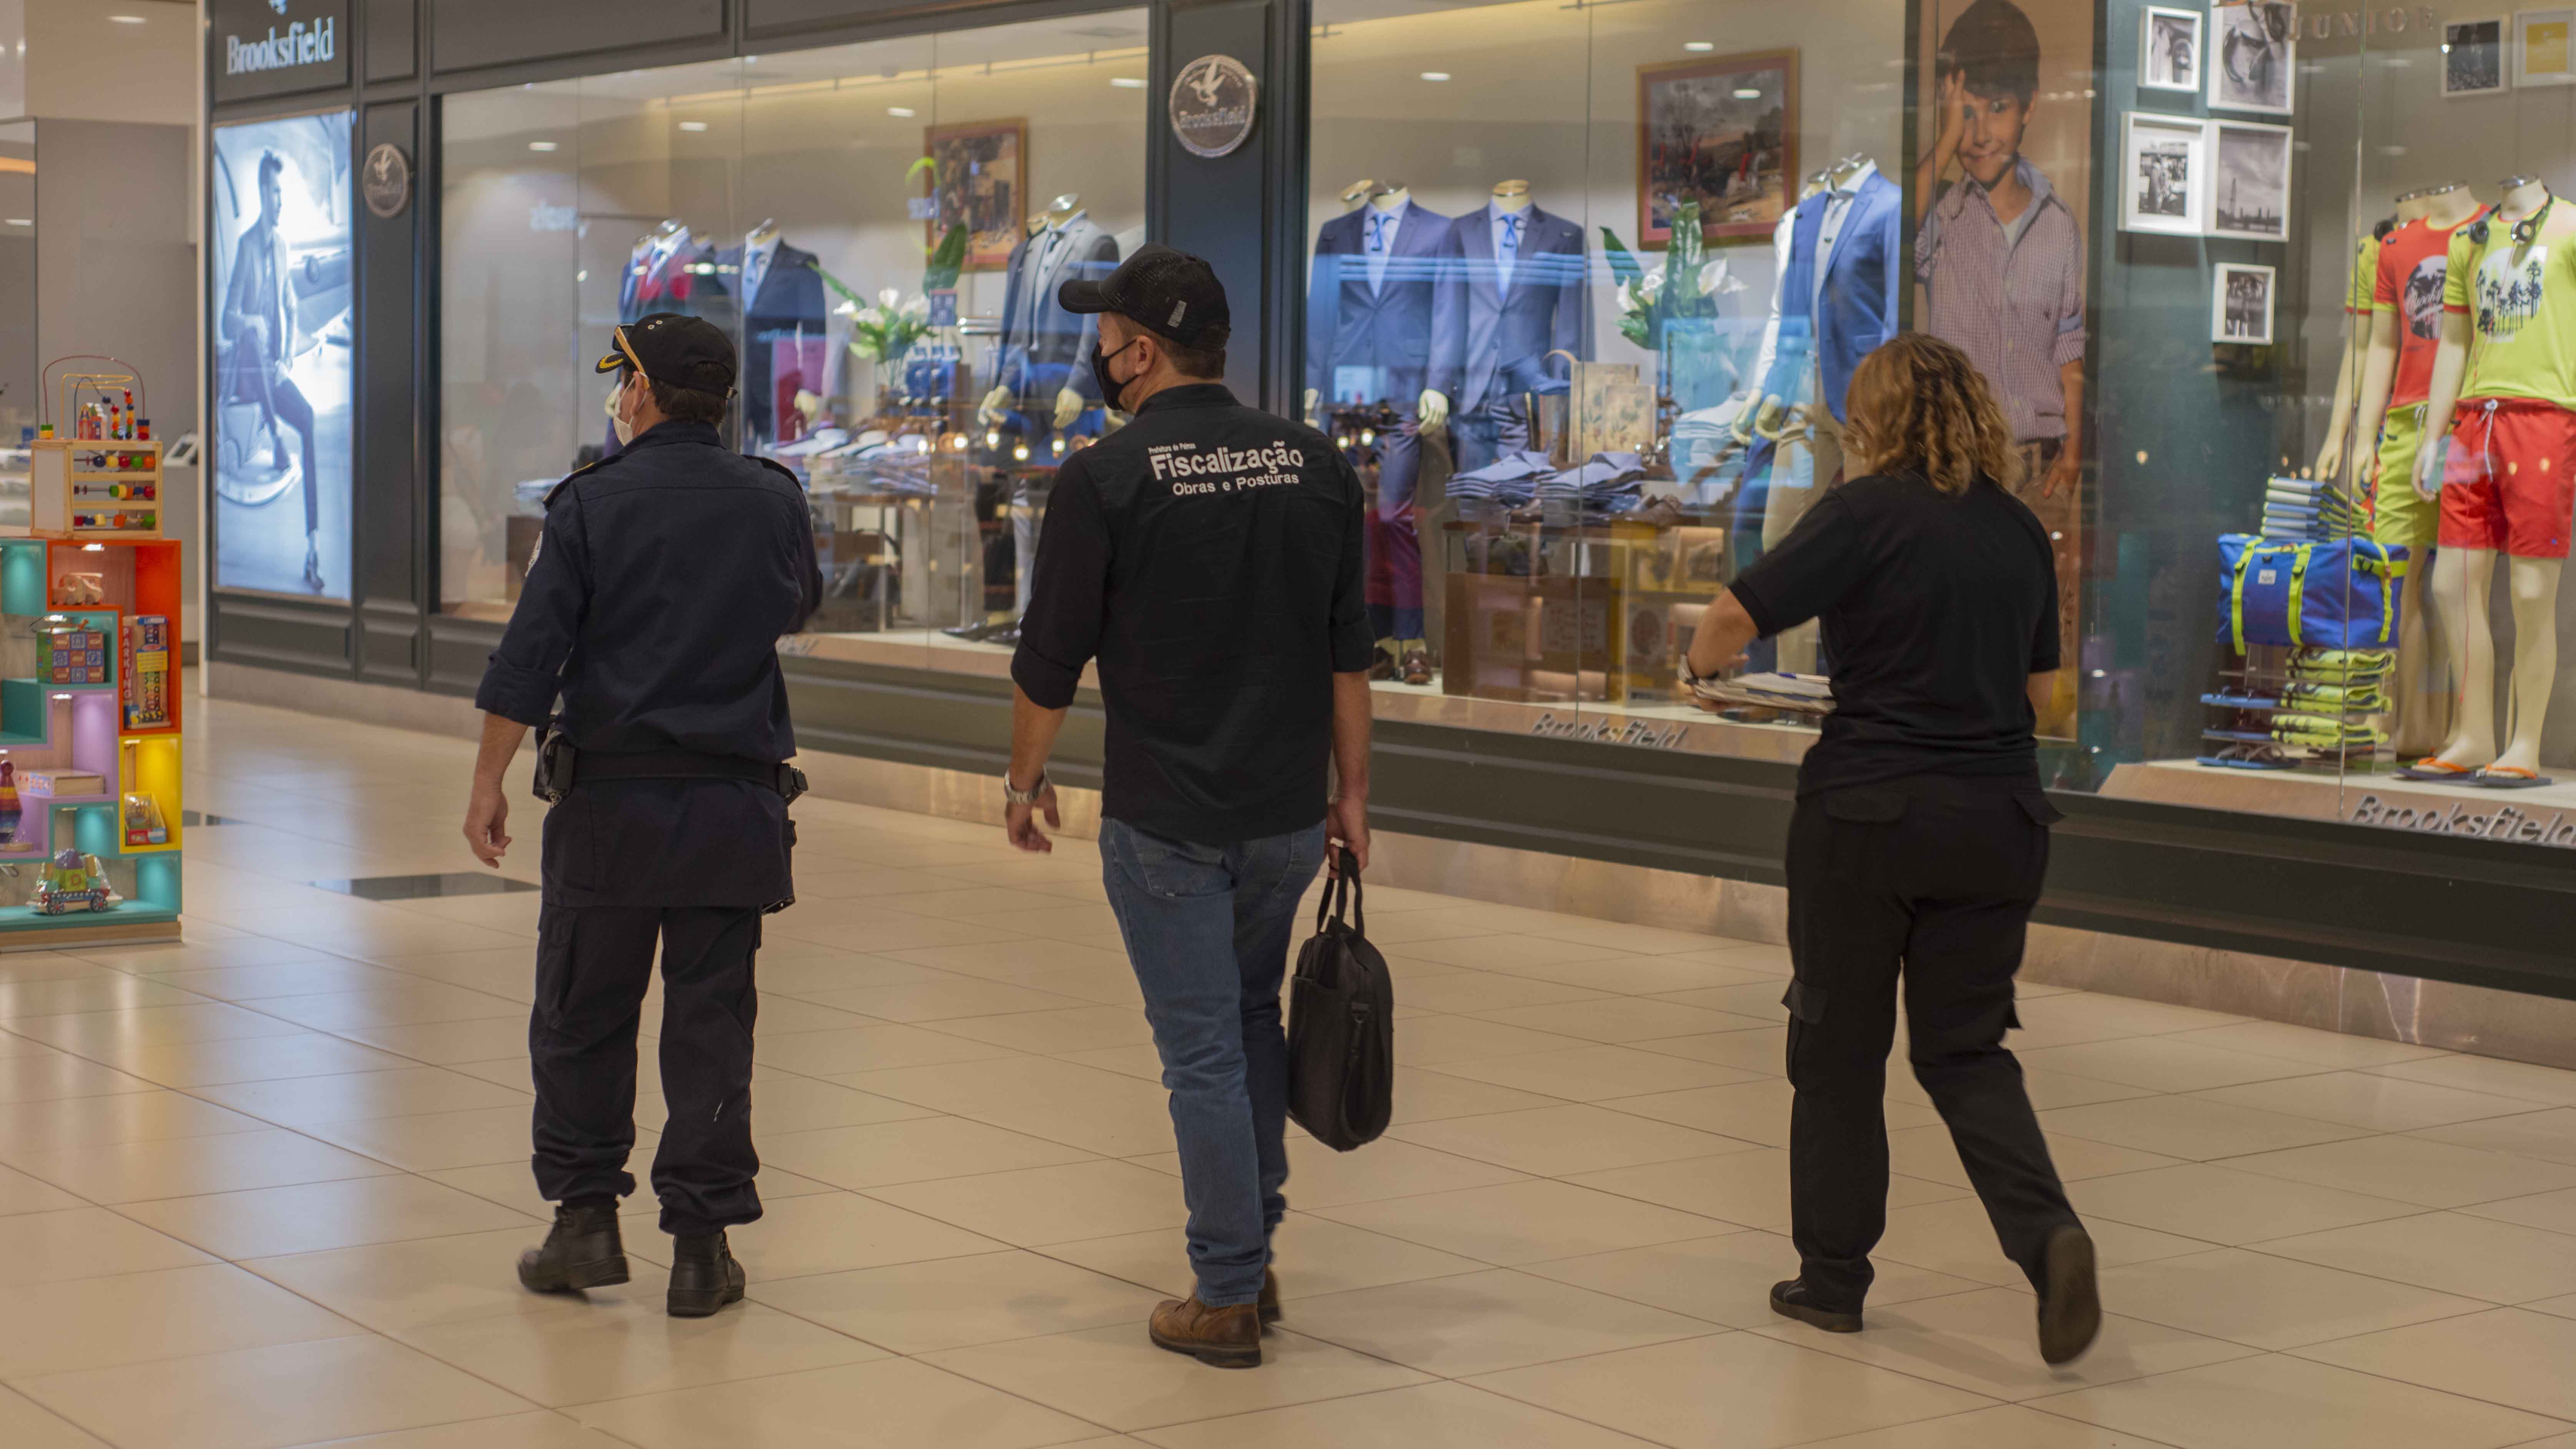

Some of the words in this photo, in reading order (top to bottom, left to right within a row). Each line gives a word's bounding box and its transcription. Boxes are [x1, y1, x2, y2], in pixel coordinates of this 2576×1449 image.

[226, 16, 335, 75] Brooksfield
[1150, 441, 1304, 480] Fiscalização
[1172, 482, 1216, 496] Obras
[1222, 481, 1231, 491] e
[1236, 474, 1299, 491] Posturas
[1532, 714, 1689, 748] Brooksfield
